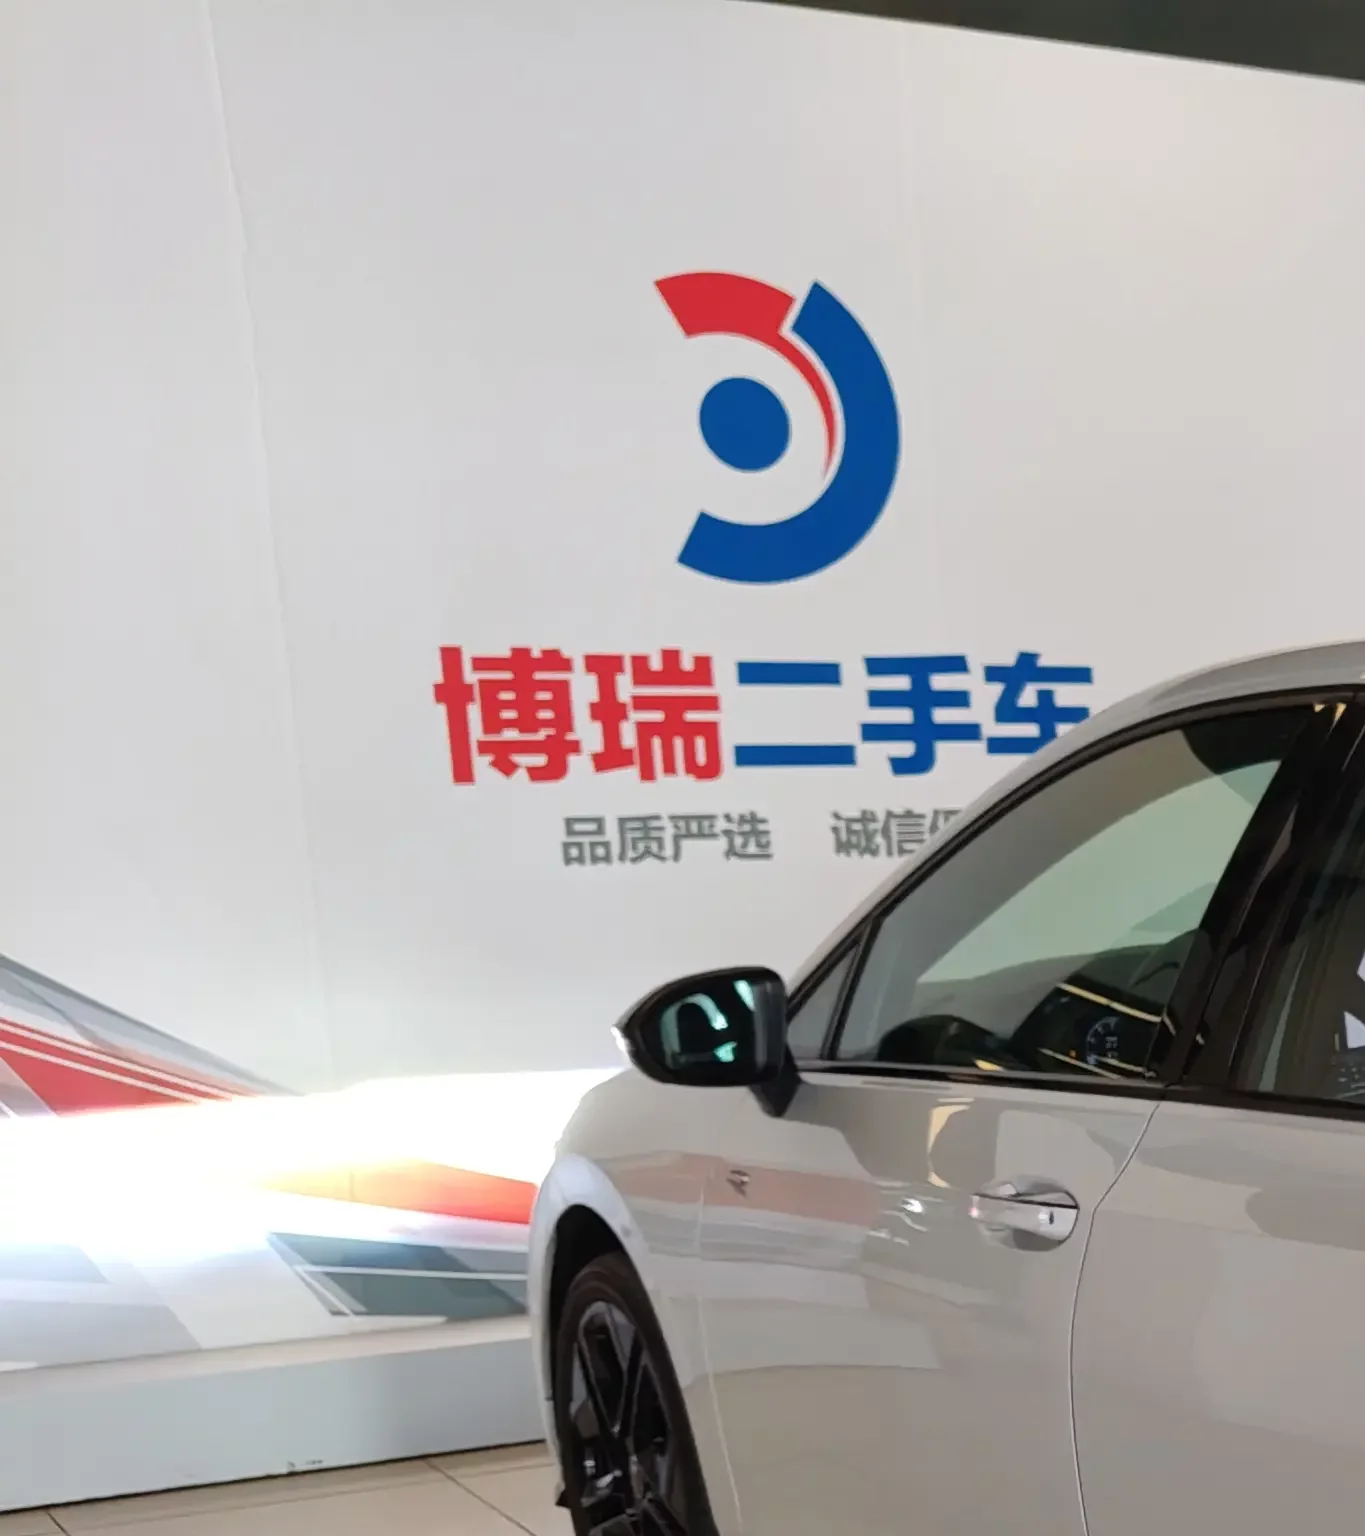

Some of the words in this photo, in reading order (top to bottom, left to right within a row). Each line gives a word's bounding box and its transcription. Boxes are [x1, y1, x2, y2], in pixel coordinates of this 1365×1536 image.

[433, 646, 1093, 785] 博瑞二手车
[561, 811, 774, 866] 品质严选
